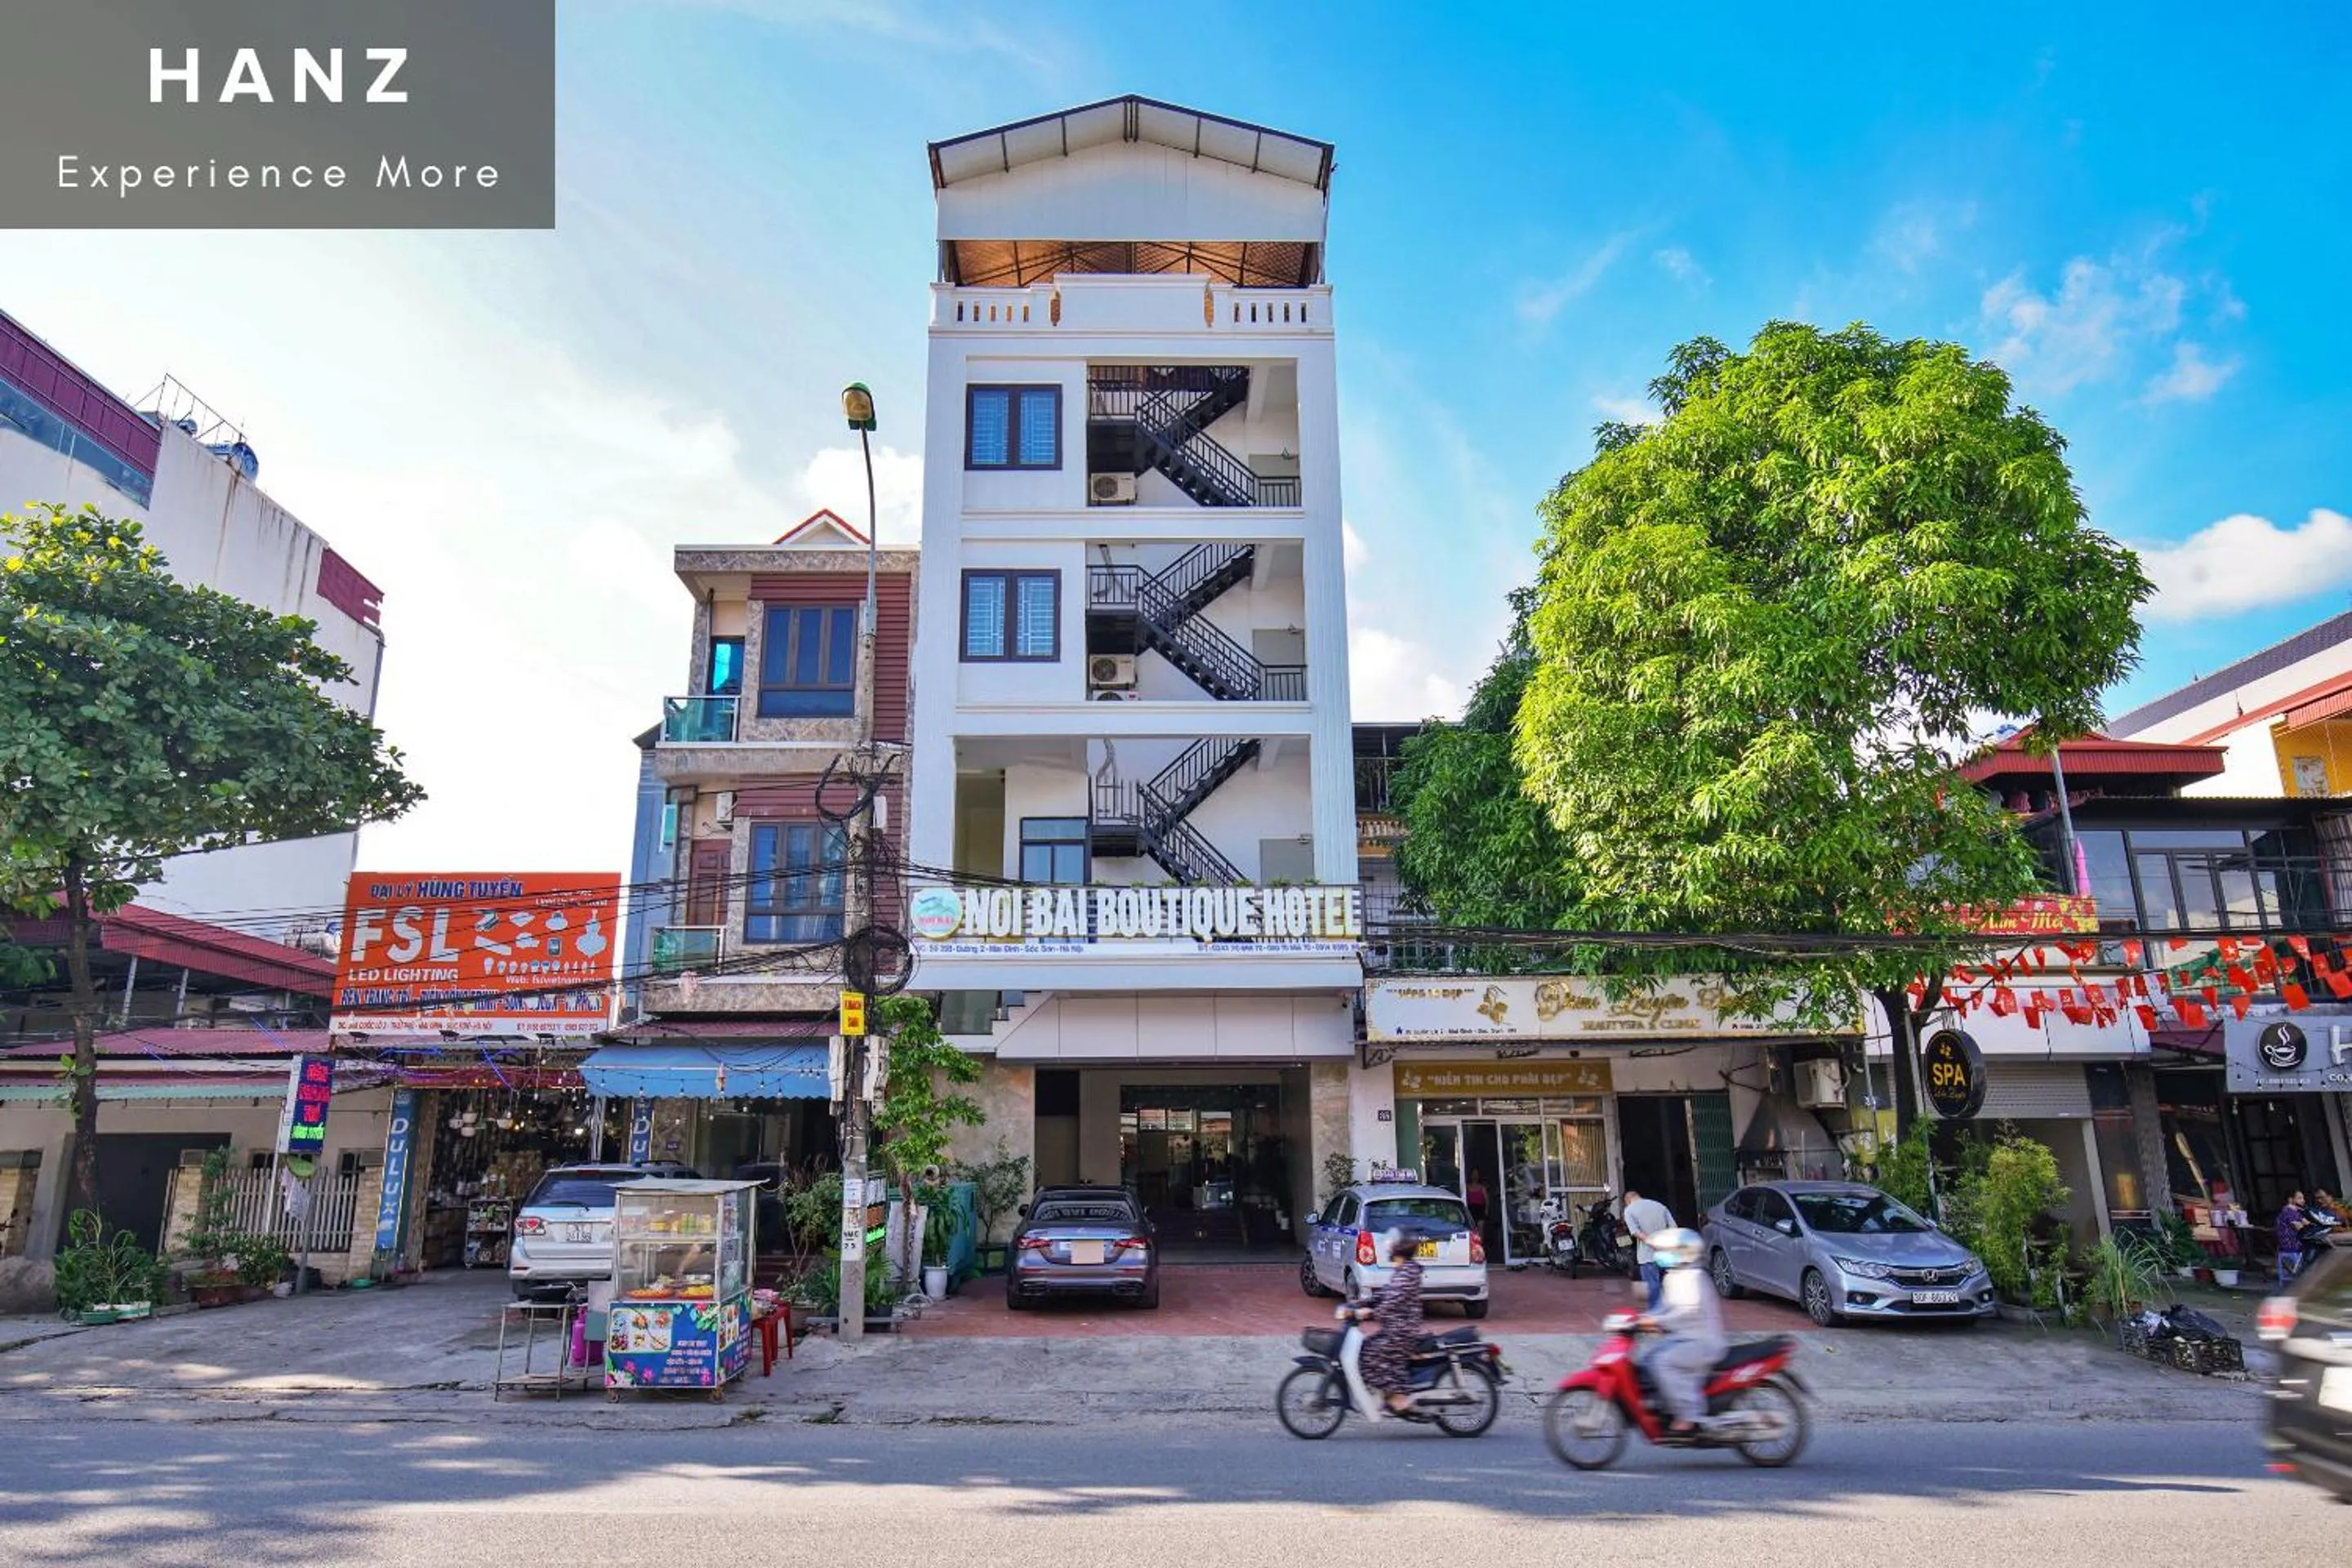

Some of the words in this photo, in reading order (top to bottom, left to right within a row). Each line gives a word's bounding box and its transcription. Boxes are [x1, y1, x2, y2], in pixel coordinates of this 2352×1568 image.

[350, 906, 459, 963] FSL
[964, 887, 1022, 937] NOI
[1031, 887, 1087, 936] BAI
[1102, 887, 1254, 943] BOUTIQUE
[1263, 887, 1362, 938] HOTEL
[349, 968, 381, 982] LED
[384, 968, 459, 982] LIGHTING
[1932, 1062, 1966, 1086] SPA
[382, 1117, 409, 1215] DULUX
